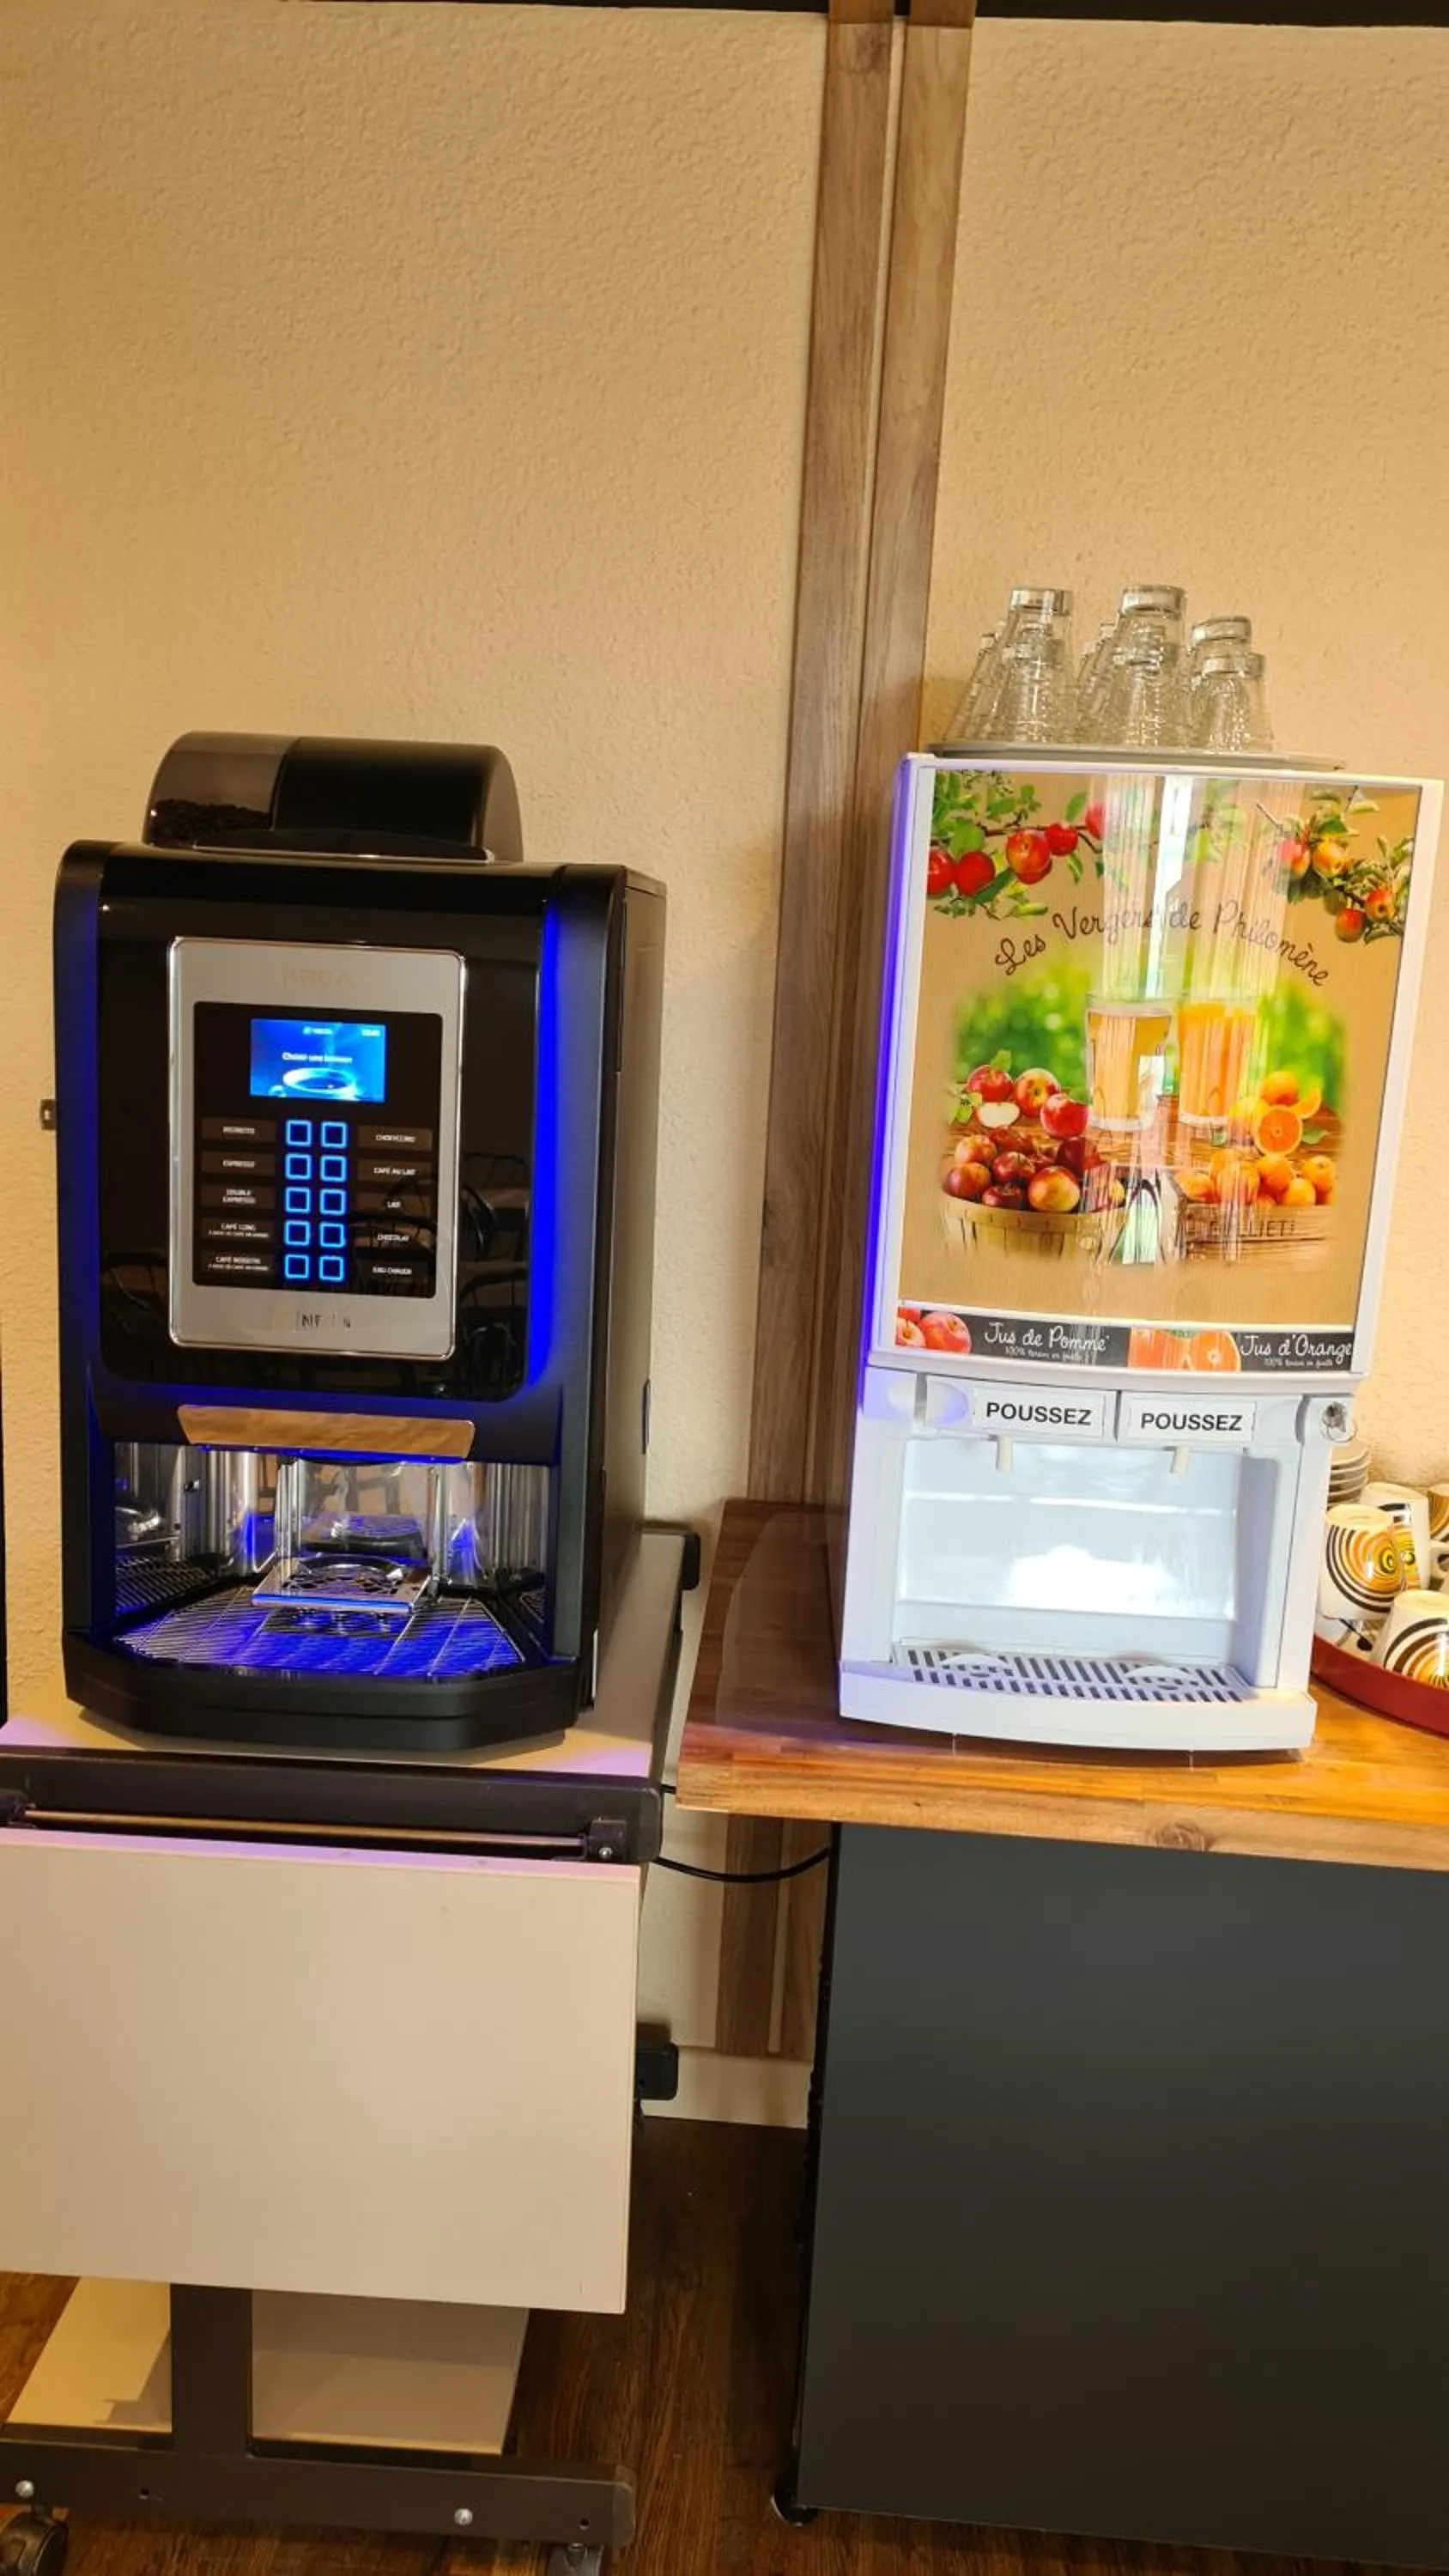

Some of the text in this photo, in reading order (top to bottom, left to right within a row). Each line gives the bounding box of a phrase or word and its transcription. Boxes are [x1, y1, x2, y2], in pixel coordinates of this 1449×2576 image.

[995, 933, 1046, 976] Les
[1168, 902, 1202, 931] de
[985, 1321, 1107, 1352] Jus de Pomme
[1240, 1334, 1352, 1365] Jus d'Orange
[986, 1401, 1092, 1426] POUSSEZ
[1141, 1413, 1243, 1431] POUSSEZ
